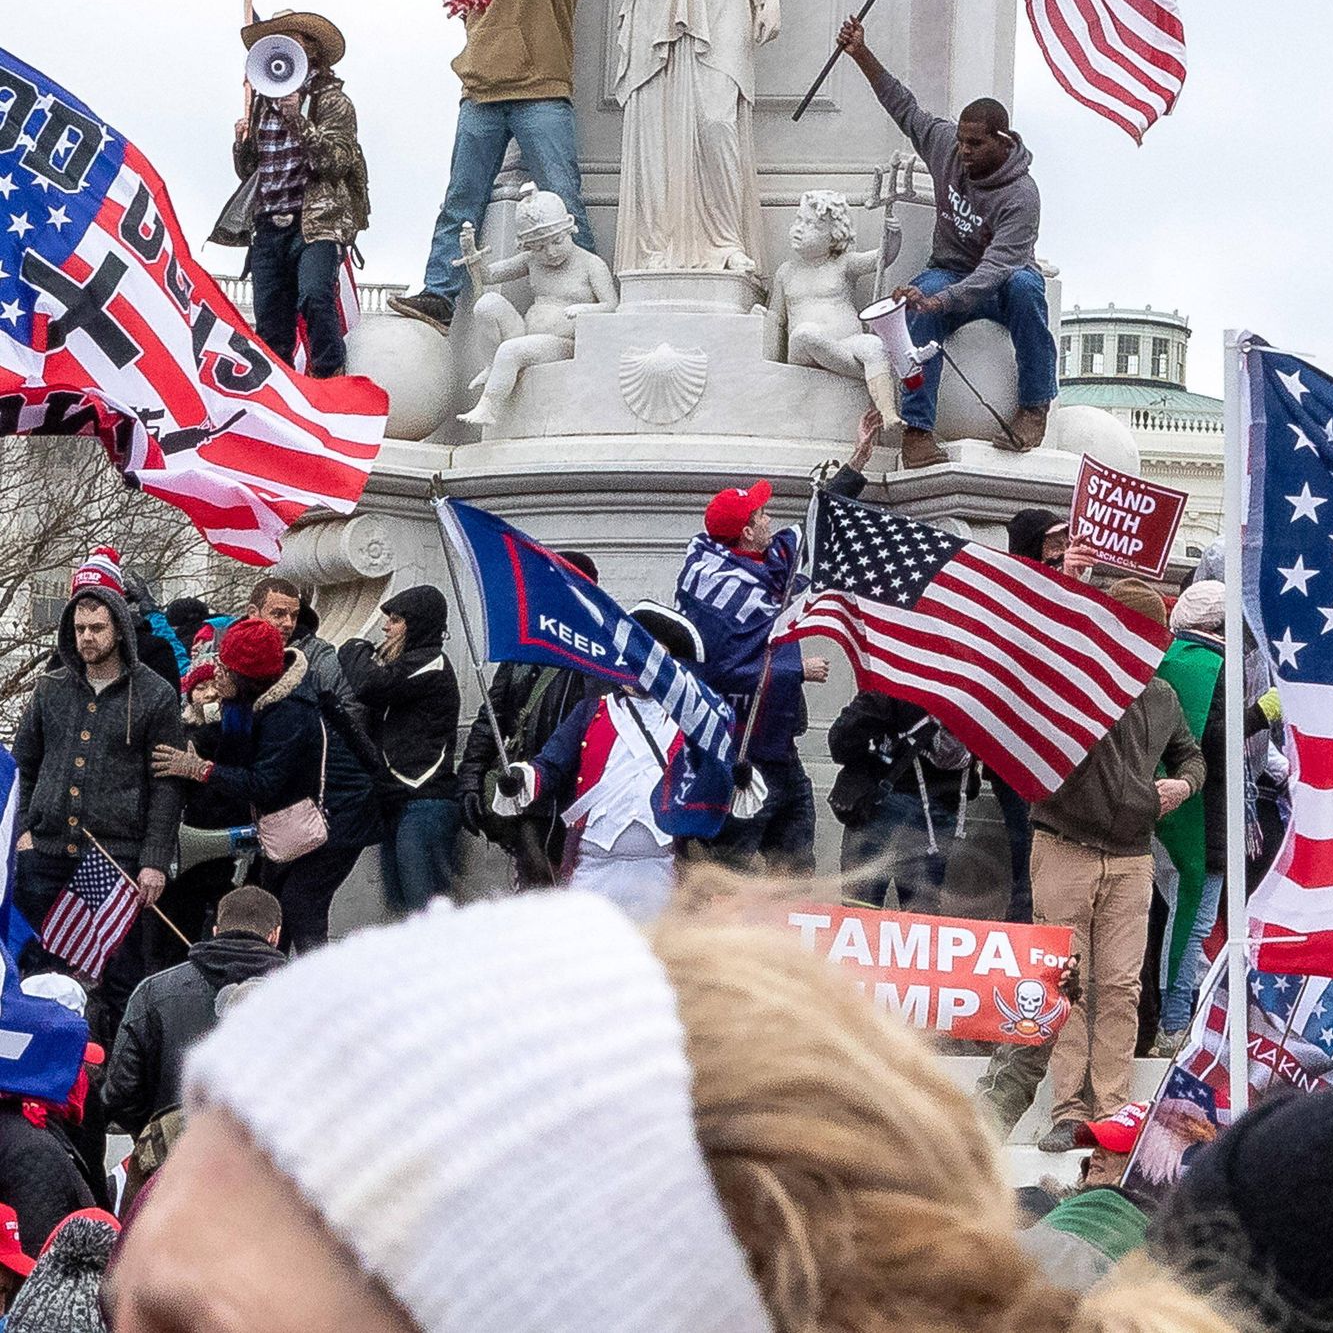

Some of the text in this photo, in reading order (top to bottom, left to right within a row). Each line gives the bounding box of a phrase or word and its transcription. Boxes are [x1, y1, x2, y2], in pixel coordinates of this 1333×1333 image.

[1087, 475, 1156, 515] STAND
[1085, 498, 1141, 534] WITH
[539, 614, 607, 657] KEEP
[788, 912, 1069, 978] TAMPA For
